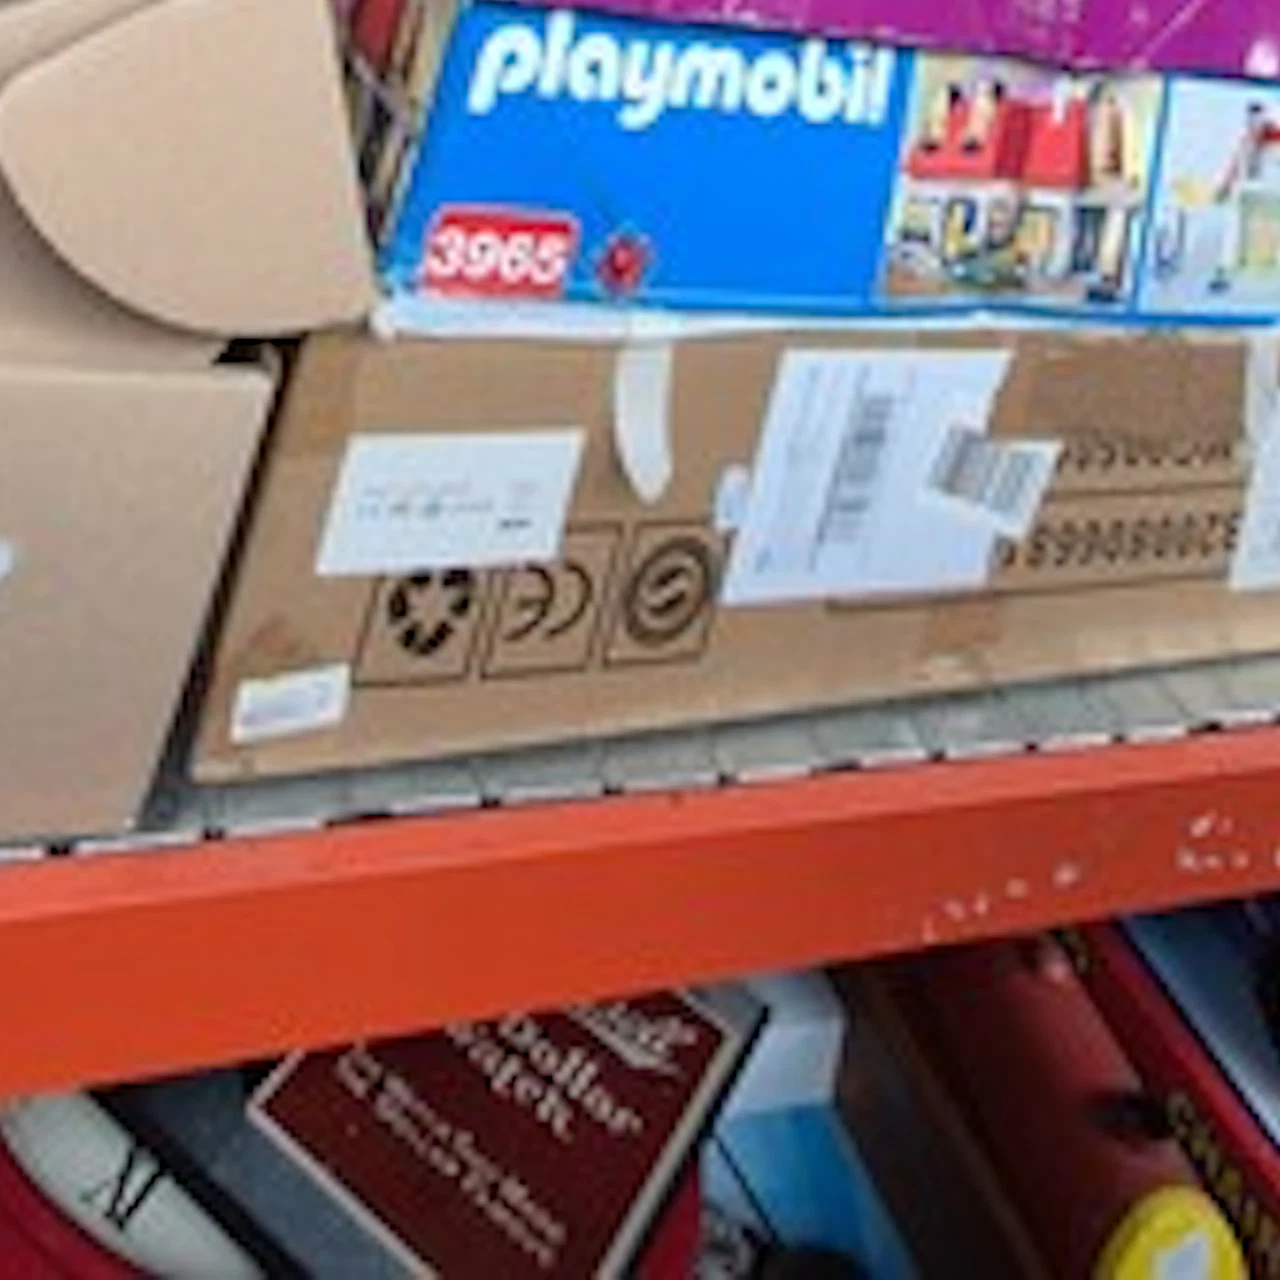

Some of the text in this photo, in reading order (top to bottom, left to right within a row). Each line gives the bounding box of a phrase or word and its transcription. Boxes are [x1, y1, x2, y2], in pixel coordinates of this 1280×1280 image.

[468, 10, 900, 132] playmobil
[424, 226, 568, 286] 3965
[496, 1012, 644, 1134] Dollar
